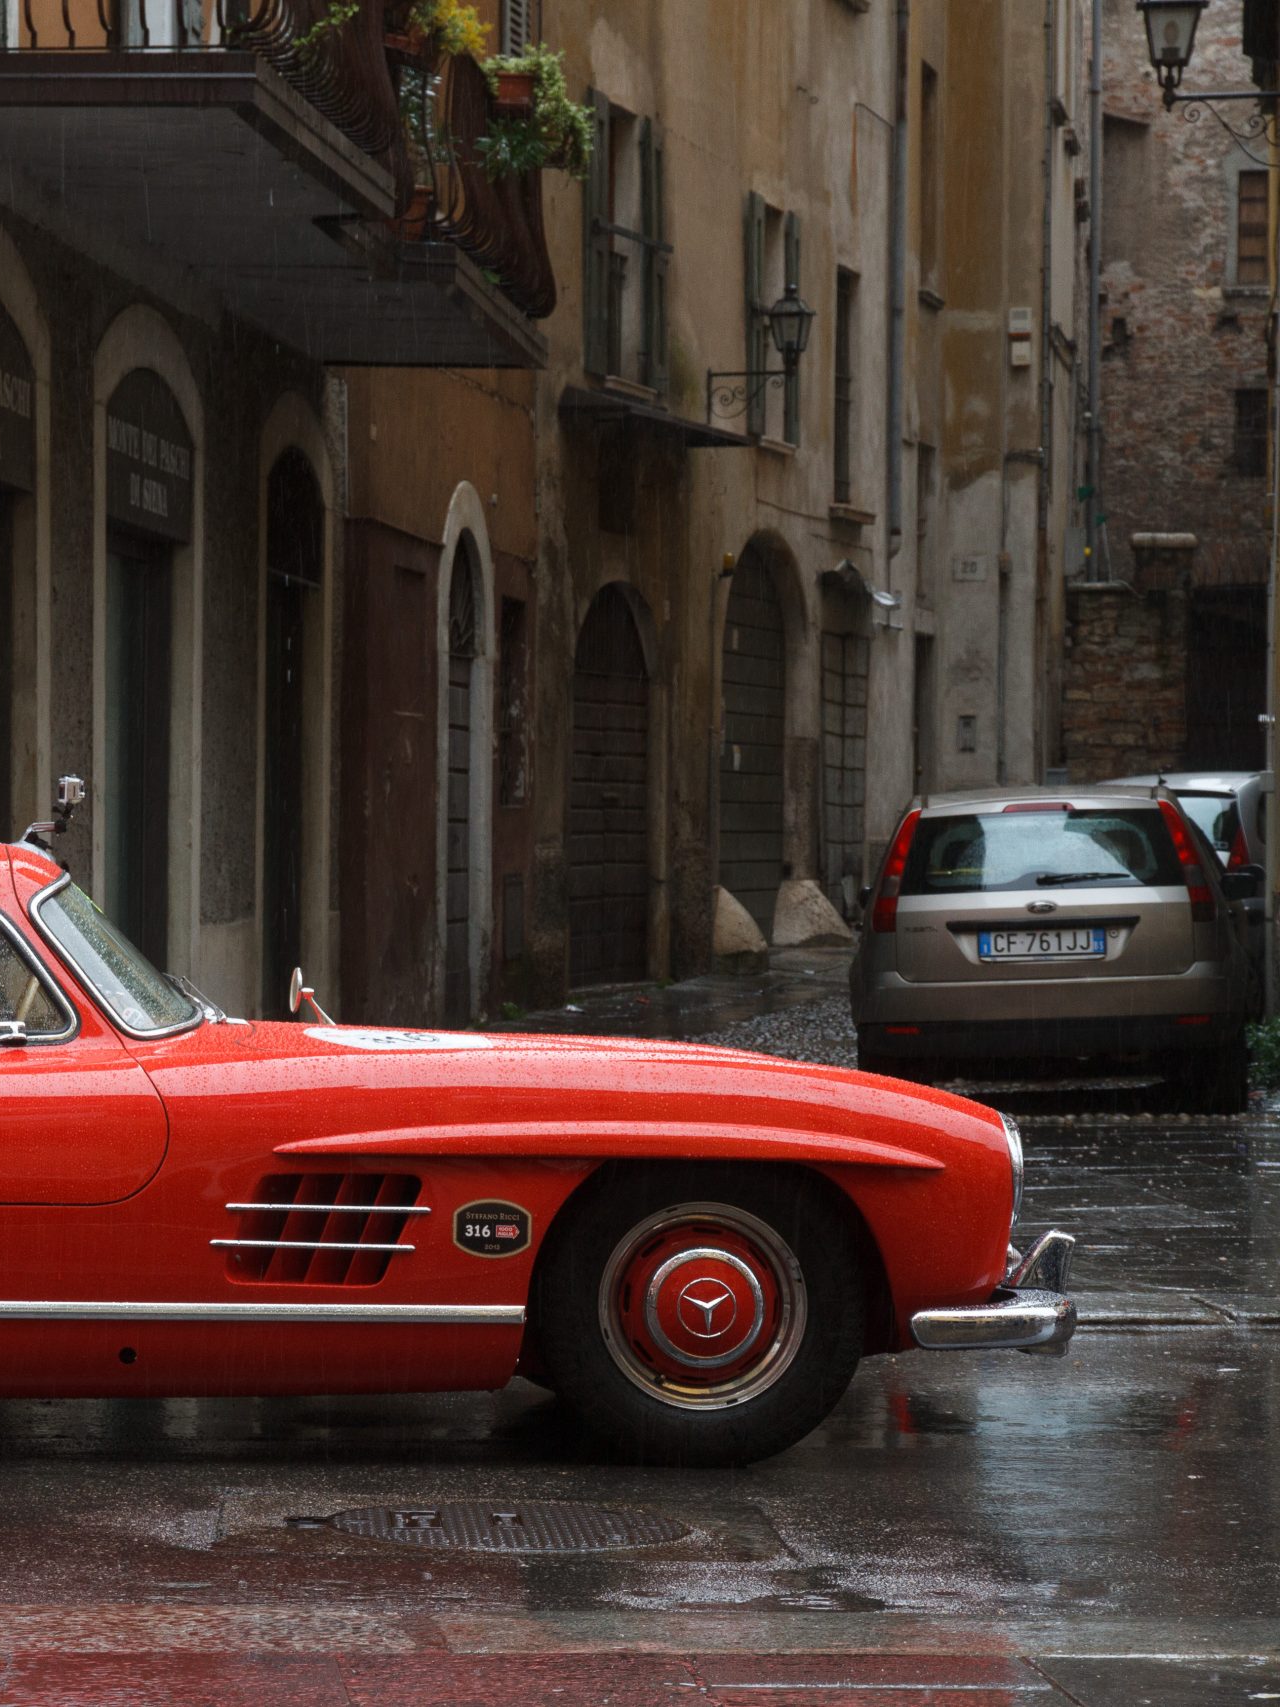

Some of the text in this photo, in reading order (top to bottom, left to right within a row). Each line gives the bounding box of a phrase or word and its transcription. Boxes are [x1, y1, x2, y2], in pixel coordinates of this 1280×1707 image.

[130, 472, 168, 518] DI SIENA
[993, 931, 1091, 953] CF 761JJ
[464, 1224, 491, 1238] 316
